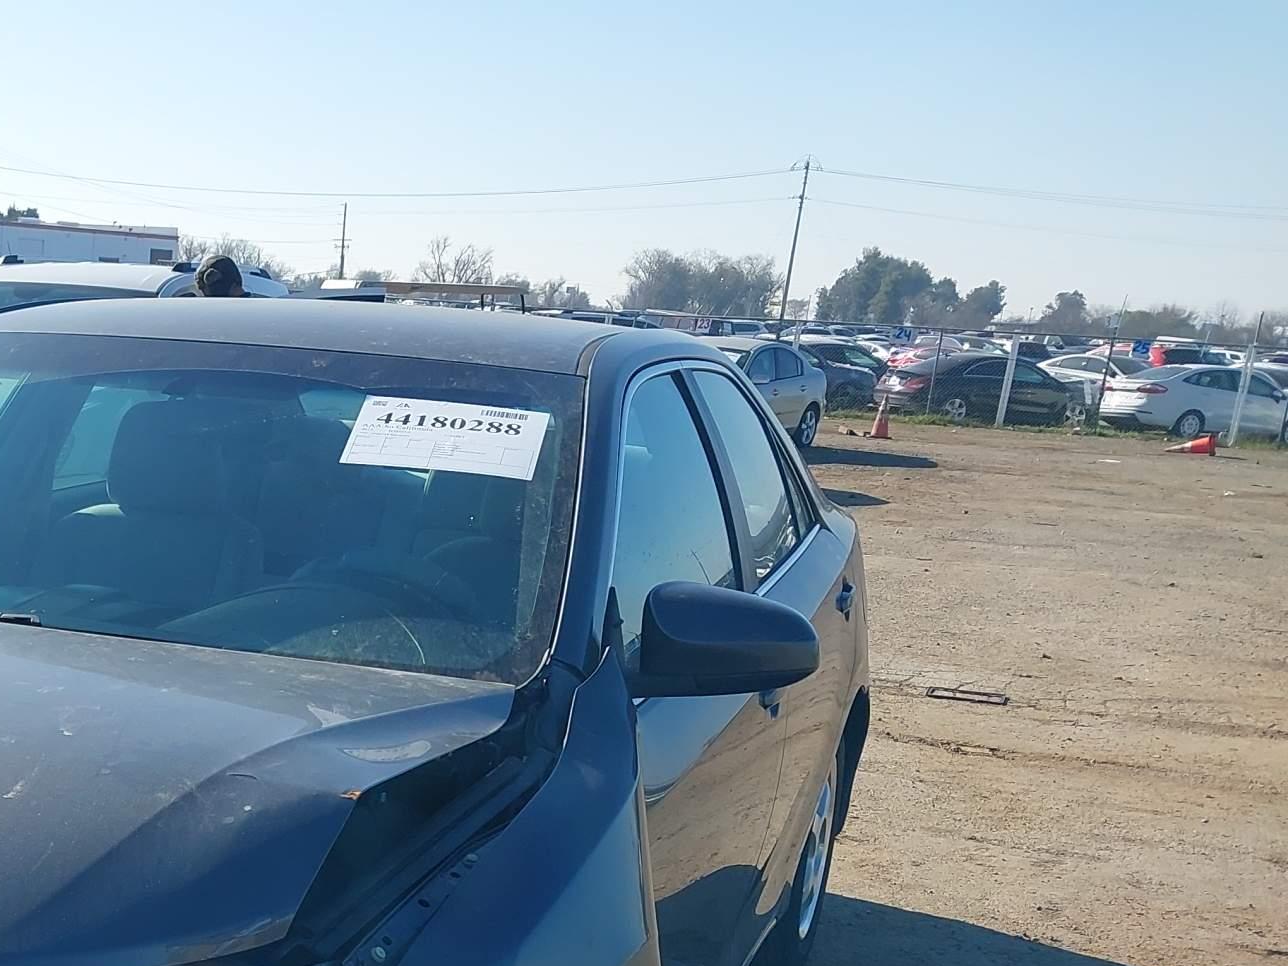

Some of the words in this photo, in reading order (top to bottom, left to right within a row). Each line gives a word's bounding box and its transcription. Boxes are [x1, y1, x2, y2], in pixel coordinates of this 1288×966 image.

[698, 318, 711, 329] 23
[895, 327, 912, 341] 24
[1132, 339, 1151, 354] 25
[376, 412, 522, 436] 44180288
